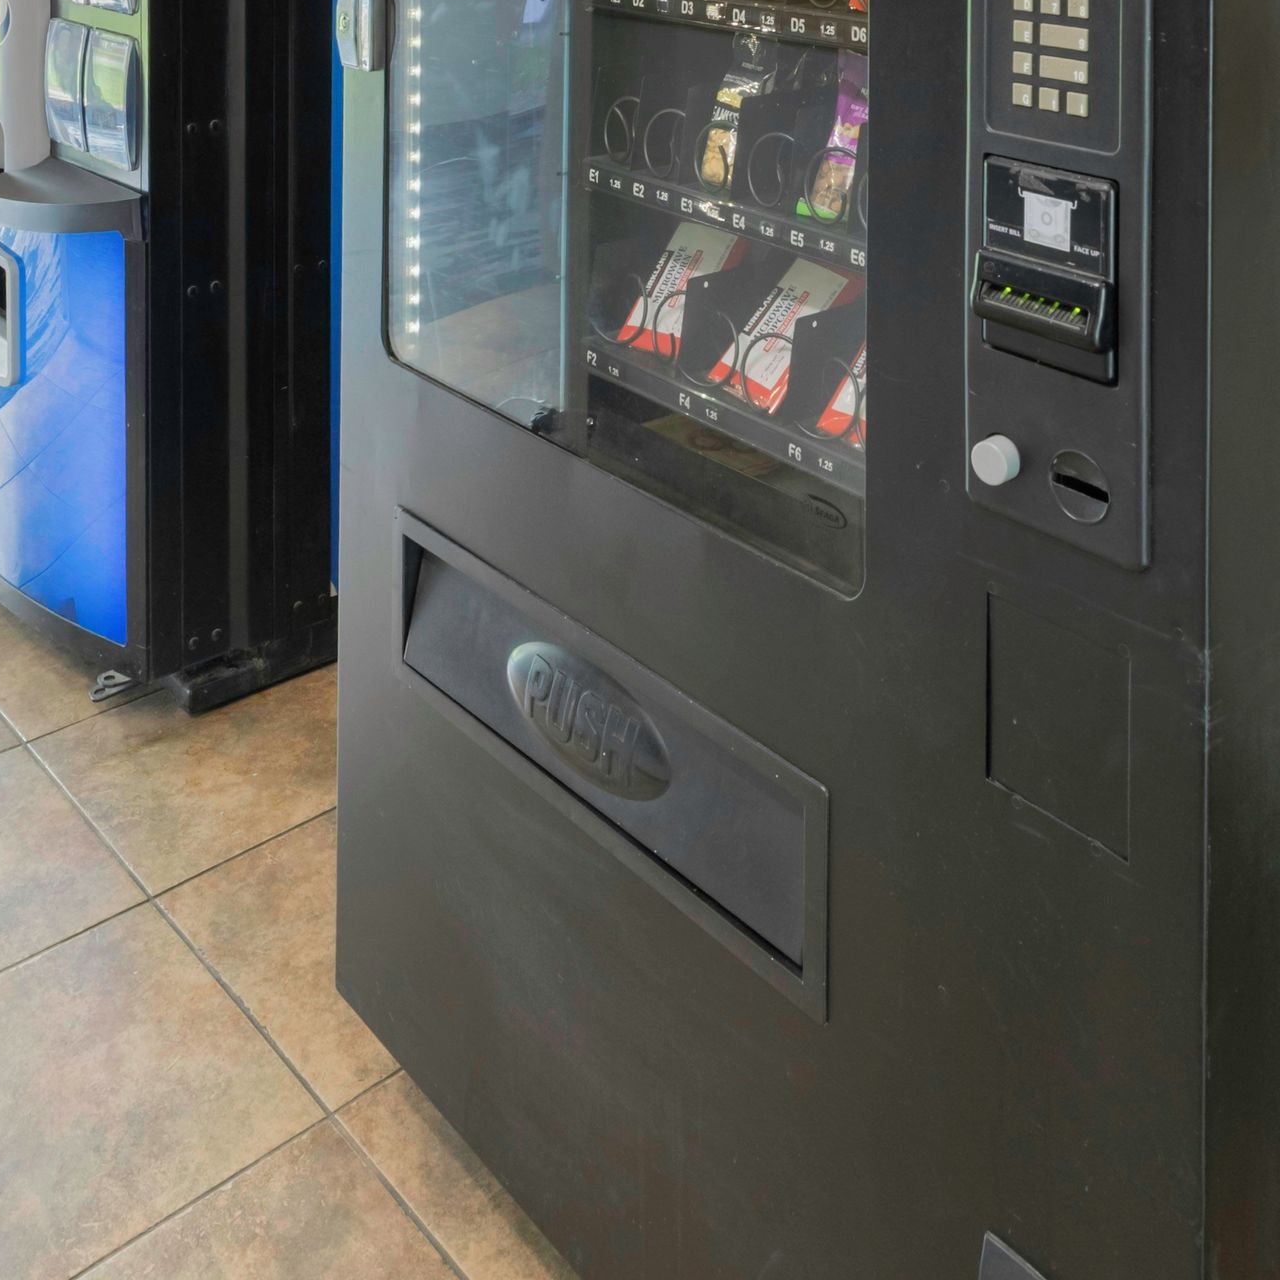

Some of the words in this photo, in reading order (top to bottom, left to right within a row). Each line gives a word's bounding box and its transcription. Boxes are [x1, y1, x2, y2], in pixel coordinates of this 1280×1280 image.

[681, 0, 694, 15] D3
[1024, 0, 1030, 10] D
[1051, 3, 1057, 13] 7
[1080, 6, 1086, 17] 8
[732, 8, 746, 24] D4
[761, 15, 775, 26] 1.25
[790, 17, 805, 34] D5
[820, 24, 835, 35] 1.25
[851, 26, 867, 43] D6
[1024, 31, 1030, 41] E
[1079, 38, 1085, 49] 9
[1023, 63, 1030, 73] F
[1073, 70, 1085, 82] 10
[1022, 94, 1029, 105] G
[589, 168, 600, 184] E1
[609, 179, 621, 189] 1.25
[632, 182, 645, 198] E2
[656, 190, 669, 201] 1.25
[680, 197, 693, 214] E3
[732, 213, 746, 230] E4
[760, 225, 774, 237] 1.25
[989, 223, 1009, 234] INSERT
[1009, 228, 1021, 238] BILL
[790, 230, 805, 248] E5
[820, 239, 835, 252] 1.25
[850, 248, 866, 267] E6
[1073, 245, 1090, 255] FACE
[1090, 249, 1100, 257] UP
[652, 245, 689, 304] MICROWAVE
[743, 288, 780, 333] KIRKLAND
[587, 350, 597, 366] F2
[608, 366, 619, 377] 1.25
[679, 392, 690, 409] F4
[705, 408, 718, 421] 1.25
[788, 443, 802, 461] F6
[818, 458, 833, 472] 1.25
[524, 653, 641, 787] PUSH
